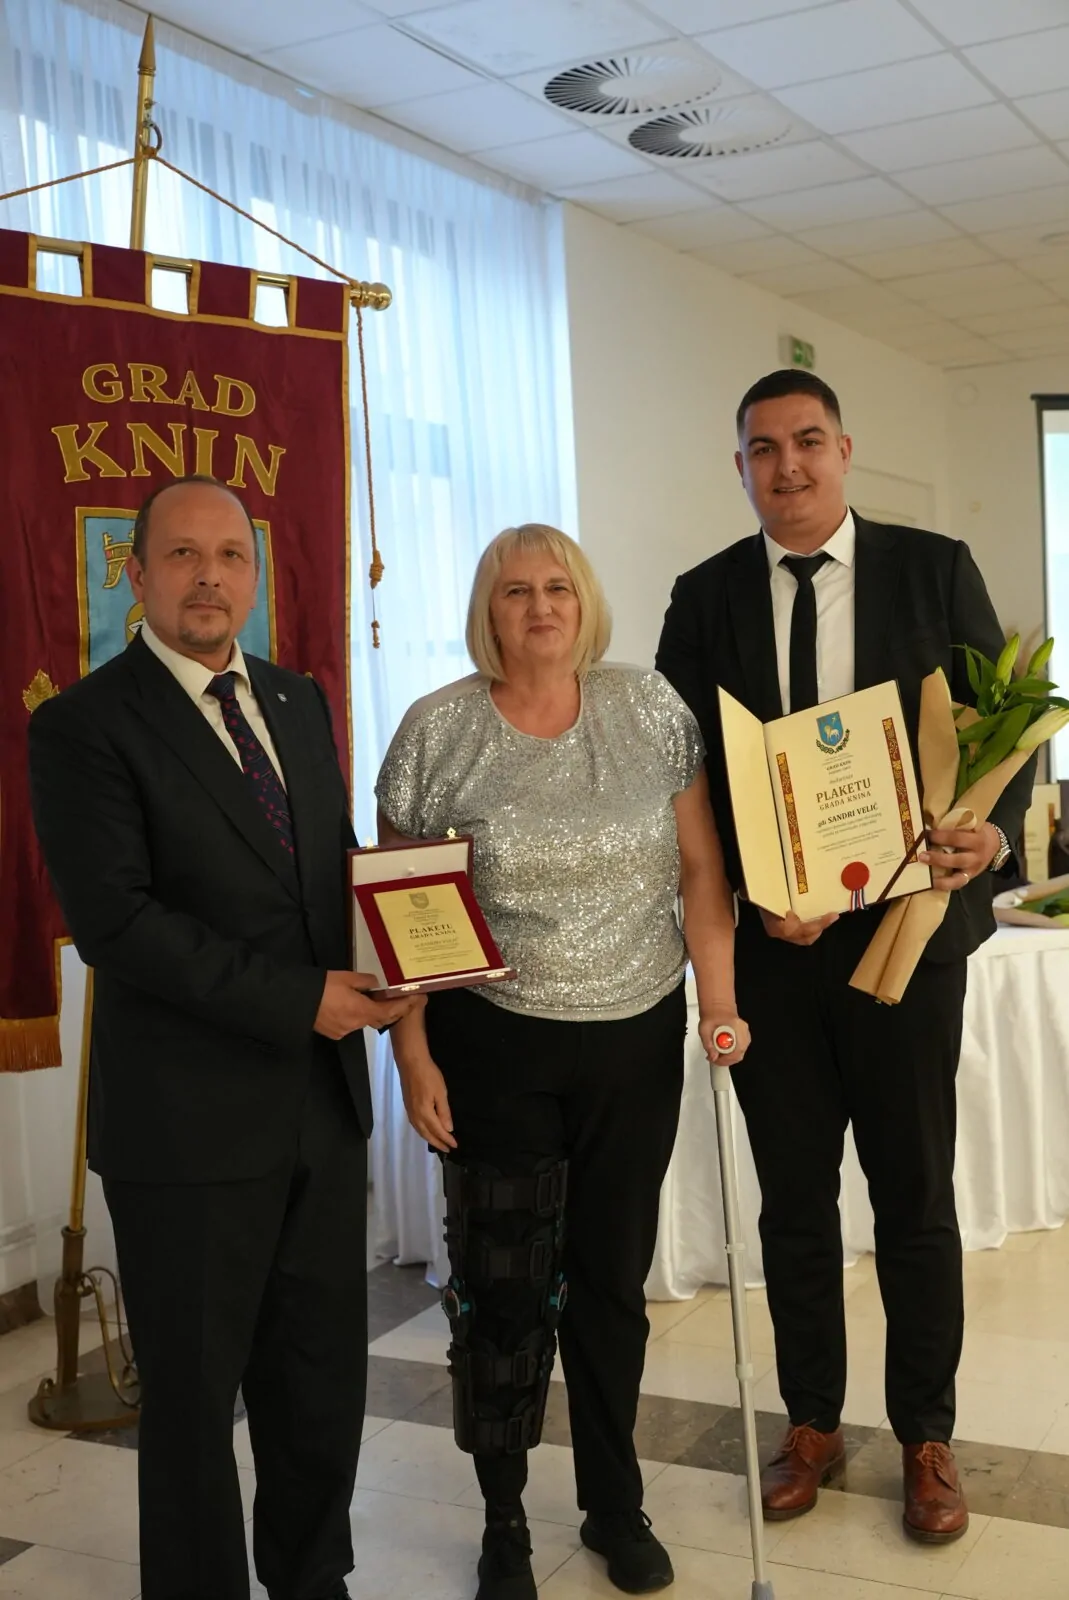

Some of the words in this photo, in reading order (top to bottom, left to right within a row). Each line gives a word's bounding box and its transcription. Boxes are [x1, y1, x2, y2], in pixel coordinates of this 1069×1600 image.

[82, 362, 256, 417] GRAD
[51, 421, 286, 496] KNIN
[816, 778, 871, 803] PLAKETU
[819, 799, 845, 810] GRADA
[847, 791, 871, 802] KNINA
[828, 810, 855, 823] SANDRI
[856, 802, 878, 815] VELIĆ
[409, 924, 452, 934] PLAKETU
